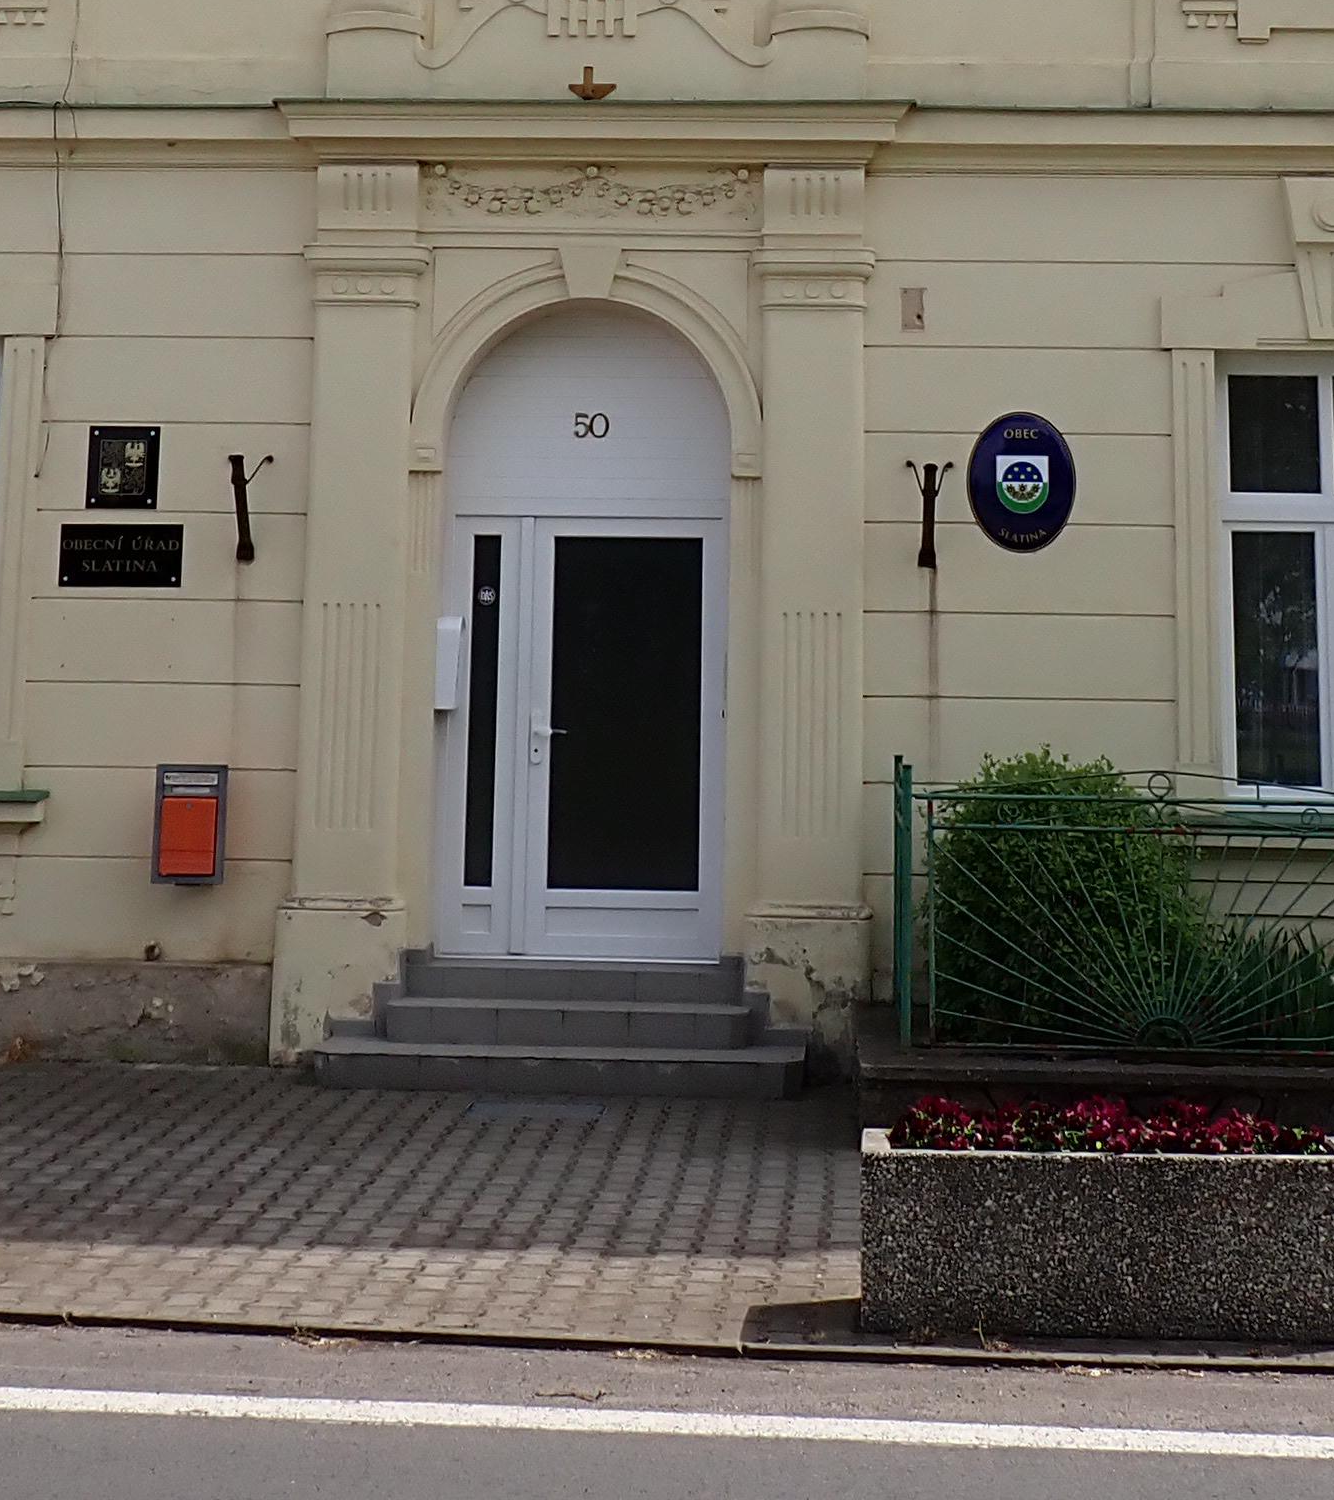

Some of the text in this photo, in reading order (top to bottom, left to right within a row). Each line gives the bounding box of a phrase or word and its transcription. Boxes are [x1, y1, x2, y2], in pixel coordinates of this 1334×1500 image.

[573, 412, 610, 439] 50
[1003, 428, 1039, 440] OBEC
[62, 535, 180, 551] OBECNÍ ÚŘAD
[998, 528, 1047, 544] SLATINA
[81, 560, 158, 573] SLATINA
